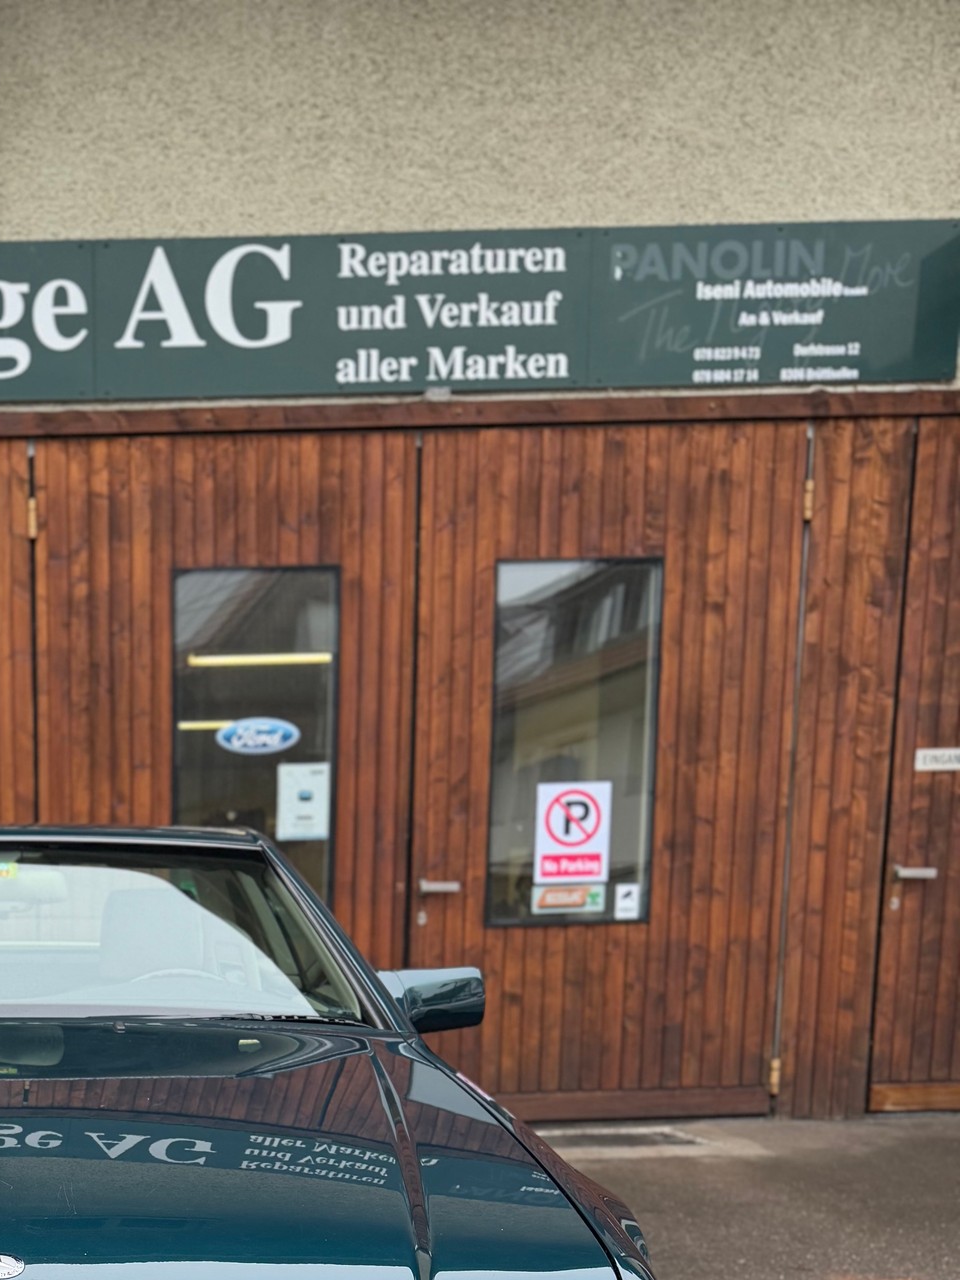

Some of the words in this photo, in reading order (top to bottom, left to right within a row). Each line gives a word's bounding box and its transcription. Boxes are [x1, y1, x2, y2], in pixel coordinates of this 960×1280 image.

[337, 242, 567, 286] Reparaturen
[610, 239, 826, 282] PANOLIN
[114, 243, 303, 349] AG
[696, 279, 741, 300] Iseni
[743, 277, 843, 299] Automobile
[337, 295, 407, 331] und
[415, 290, 563, 329] Verkauf
[738, 311, 757, 326] An
[758, 310, 771, 326] &
[771, 308, 825, 326] Verkauf
[335, 348, 418, 384] aller
[426, 345, 569, 382] Marken
